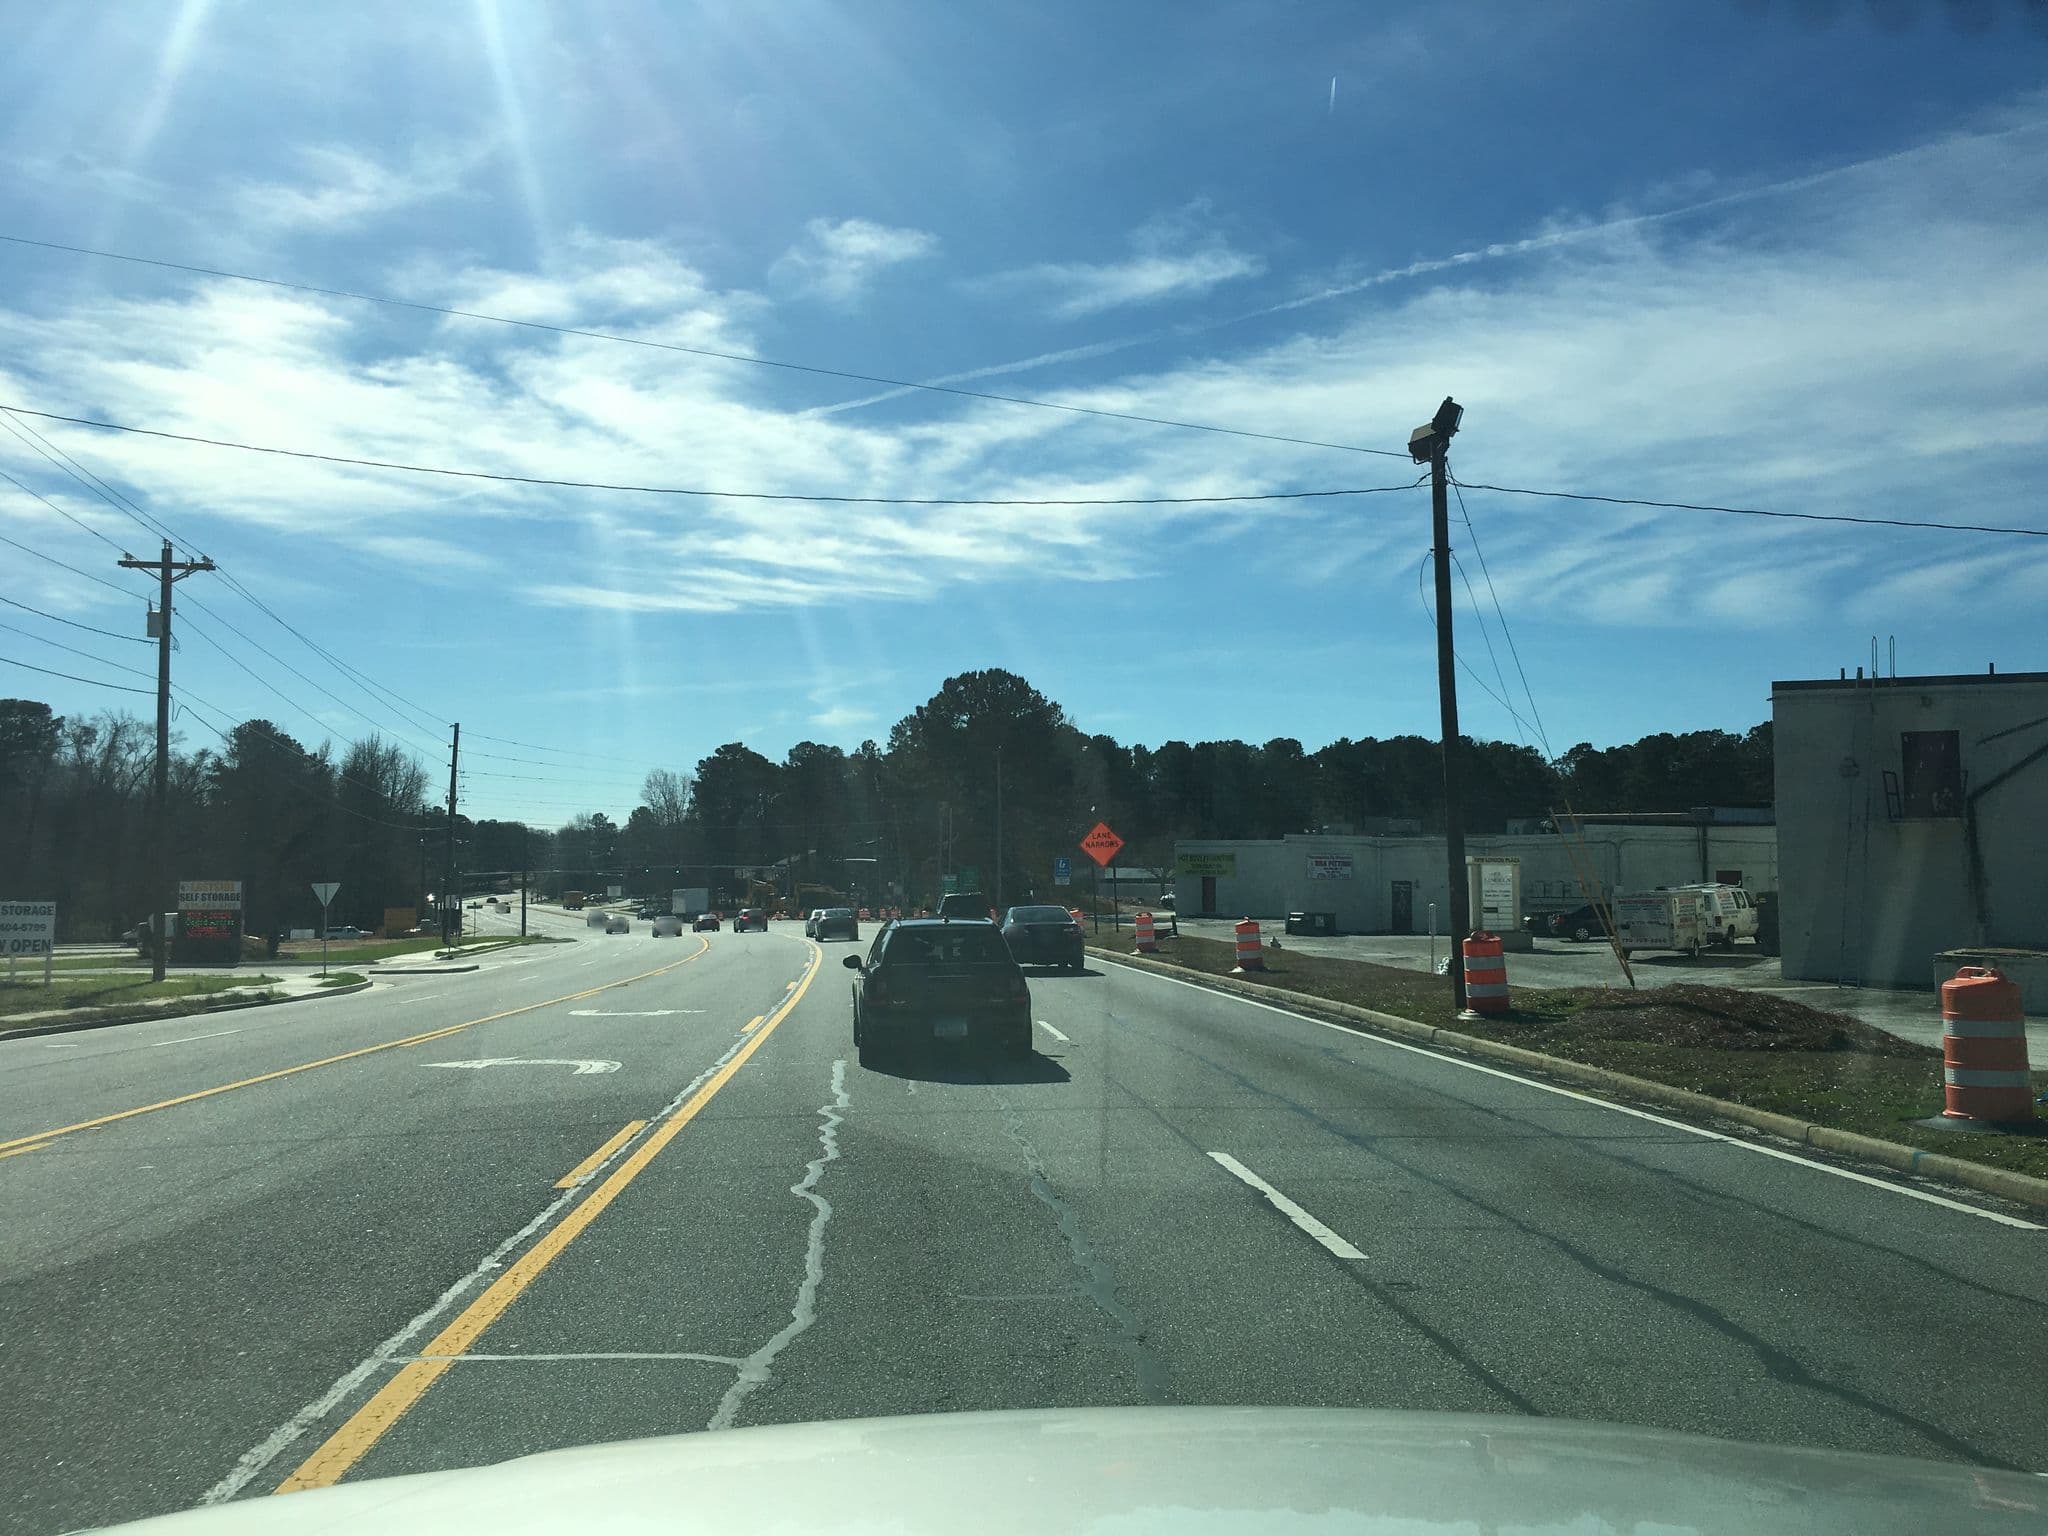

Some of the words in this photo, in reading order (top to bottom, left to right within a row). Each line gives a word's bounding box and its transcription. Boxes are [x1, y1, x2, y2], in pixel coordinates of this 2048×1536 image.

[1091, 832, 1112, 840] LANE
[179, 893, 200, 902] SELF
[201, 892, 241, 902] STORAGE
[1, 905, 55, 916] STORAGE
[11, 939, 51, 953] OPEN
